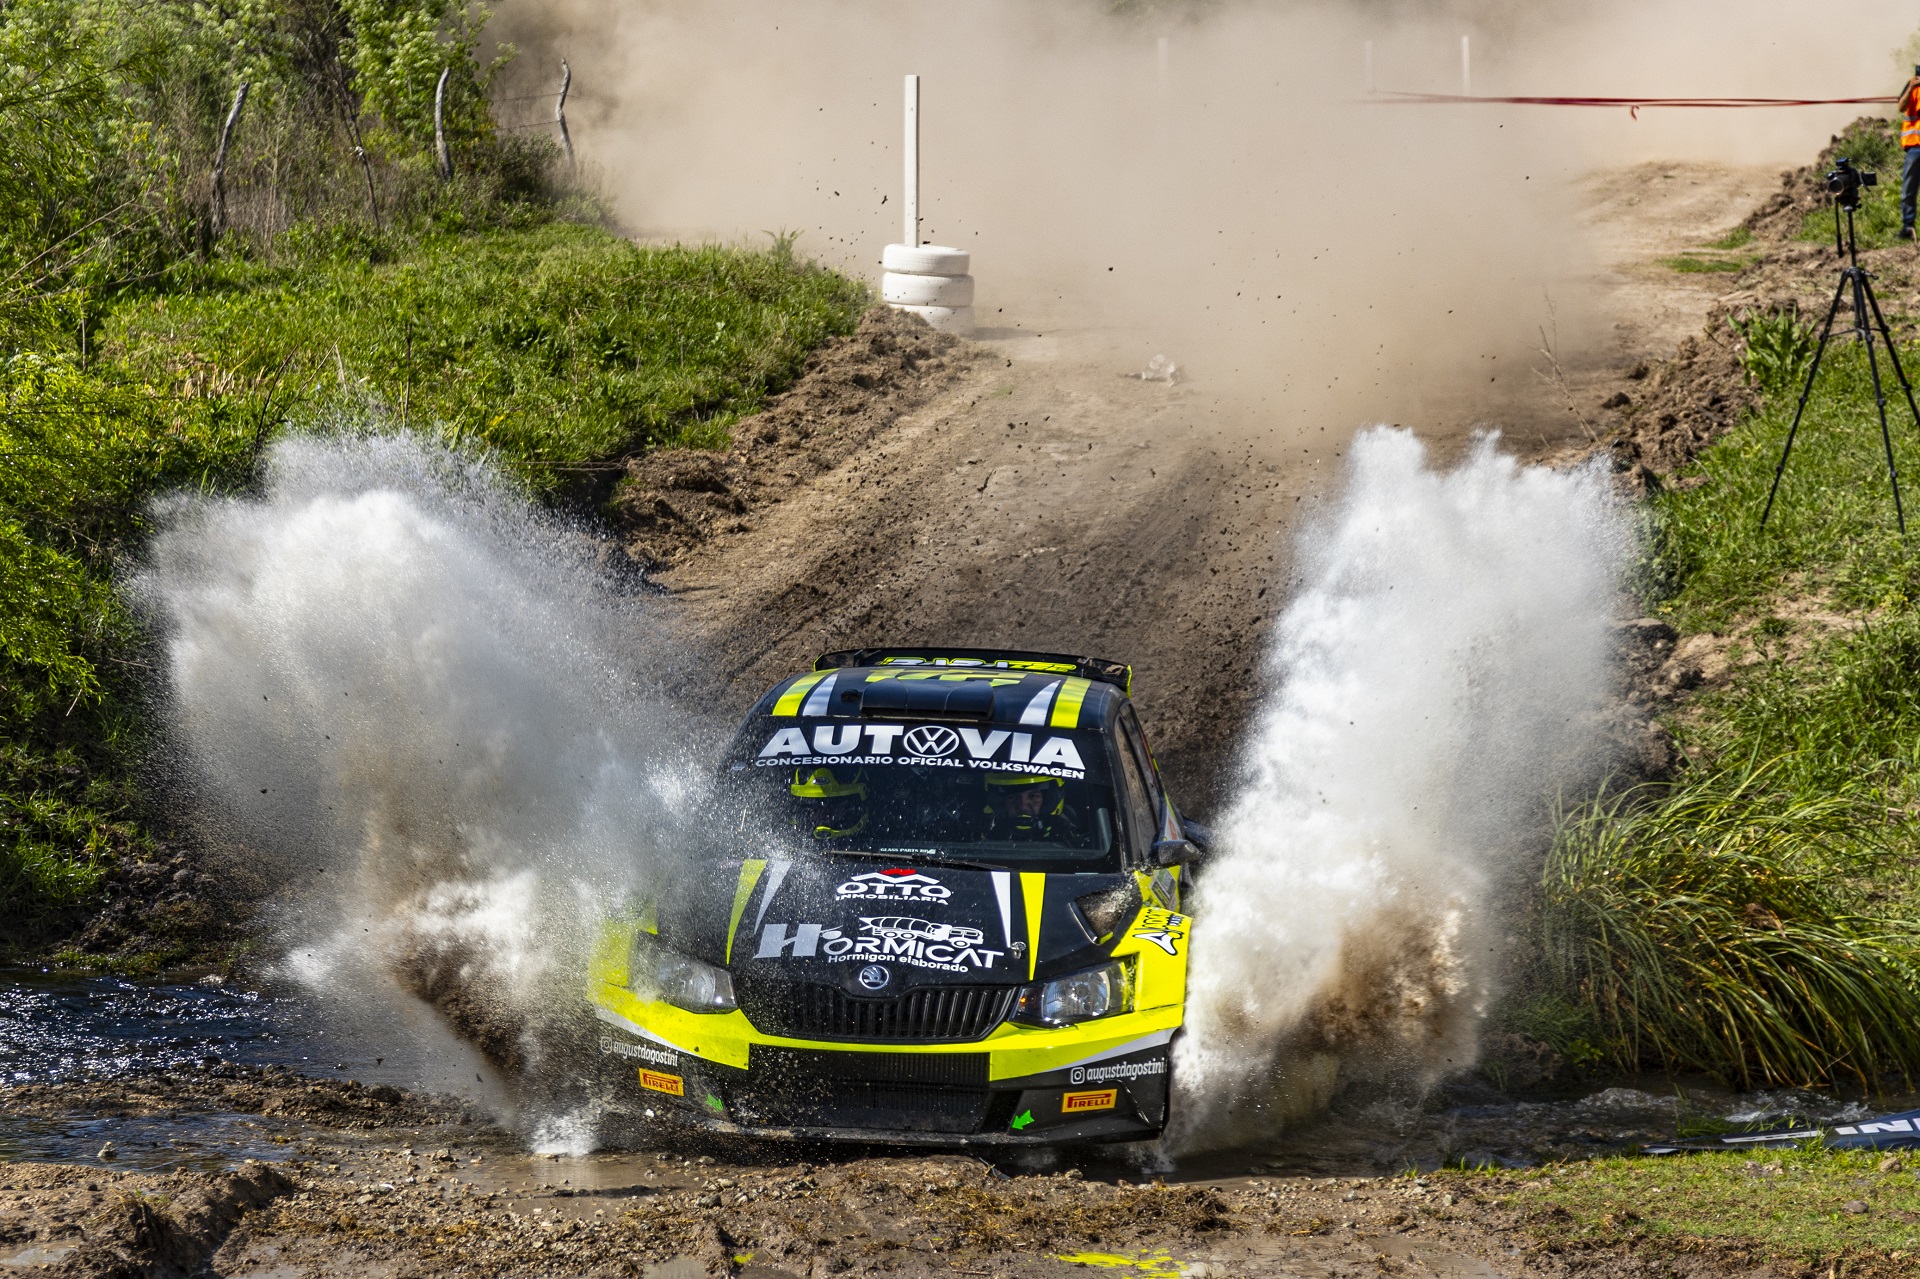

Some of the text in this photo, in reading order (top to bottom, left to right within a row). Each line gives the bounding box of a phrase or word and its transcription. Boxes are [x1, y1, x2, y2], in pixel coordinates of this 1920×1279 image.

[755, 755, 1085, 779] CONCESIONARIO OFICIAL VOLKSWAGEN
[837, 882, 951, 898] OTTO
[836, 895, 949, 905] INMOBILIARIA
[828, 954, 969, 973] Hormigon elaborado
[1087, 1057, 1164, 1083] augustdagostini
[643, 1073, 679, 1092] PIRELLI
[1067, 1093, 1112, 1108] PIRELLI
[1835, 1118, 1920, 1135] IN
